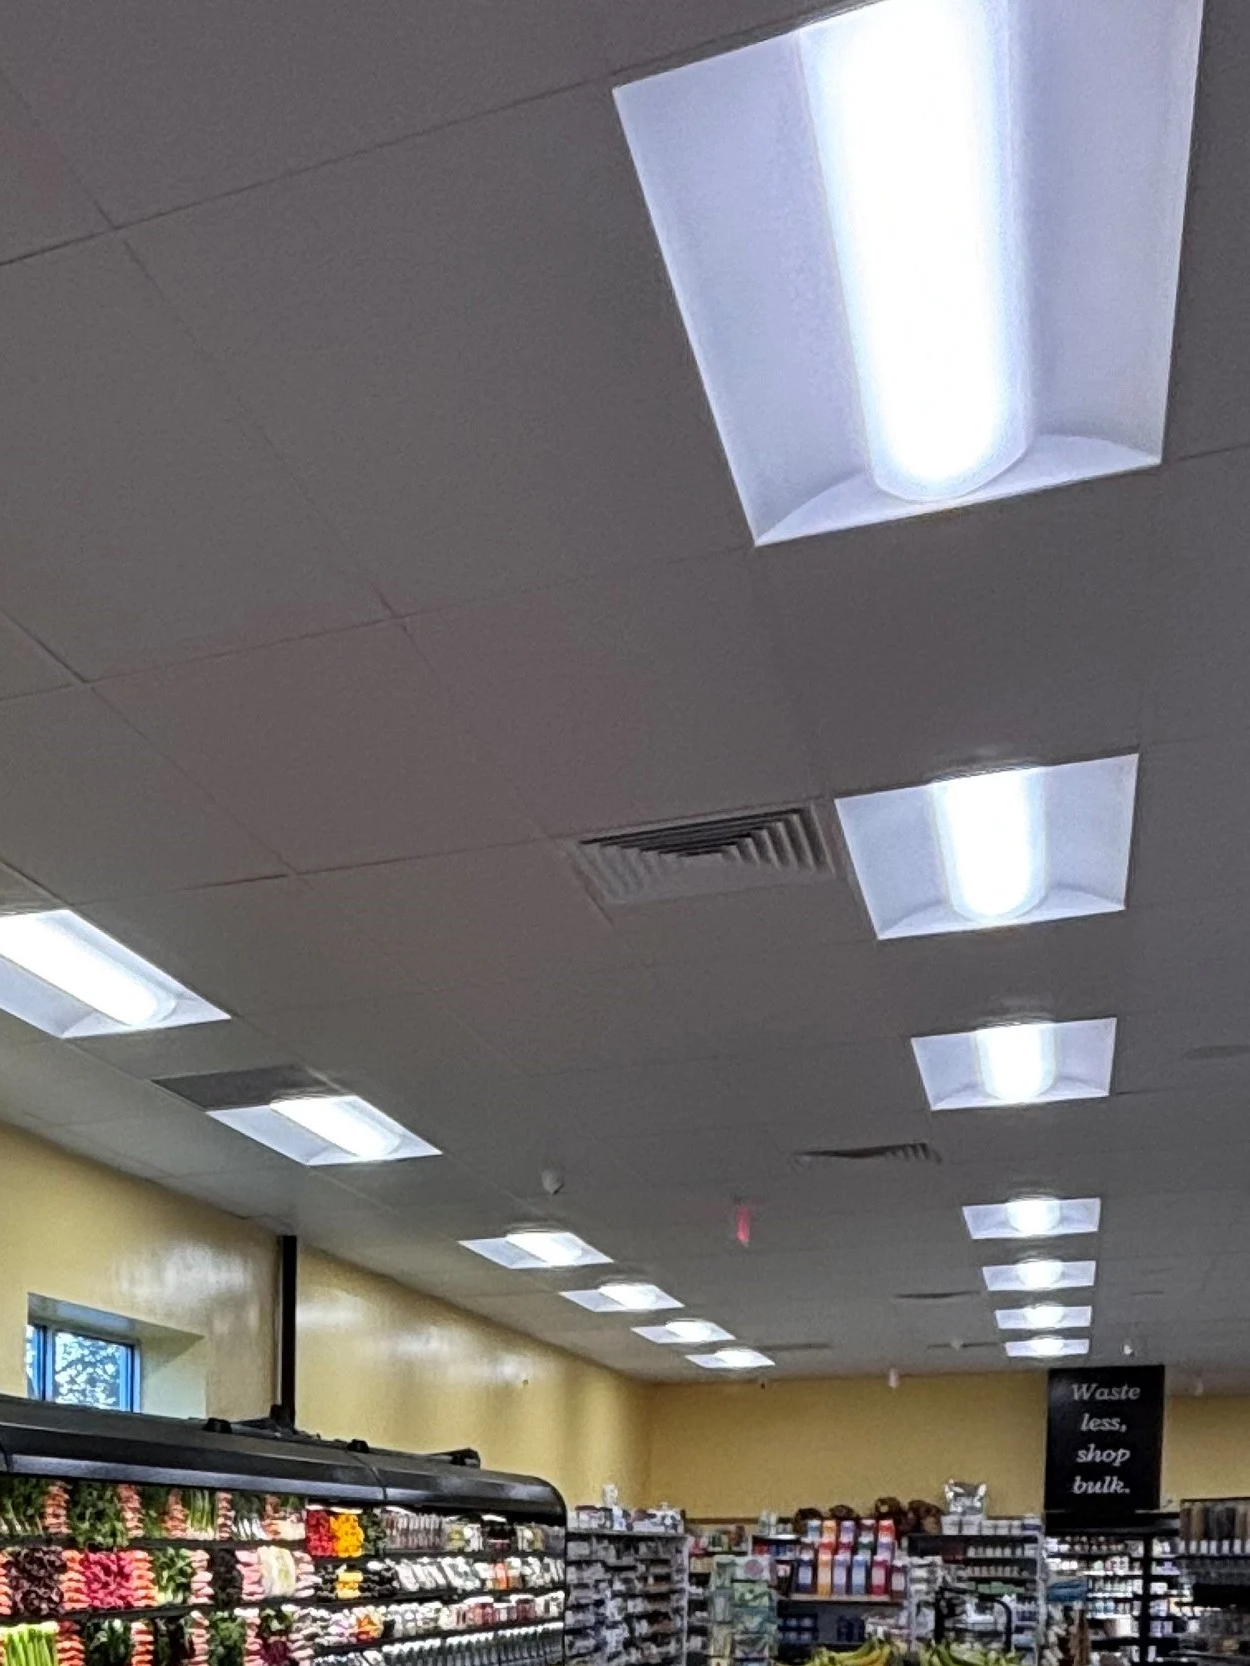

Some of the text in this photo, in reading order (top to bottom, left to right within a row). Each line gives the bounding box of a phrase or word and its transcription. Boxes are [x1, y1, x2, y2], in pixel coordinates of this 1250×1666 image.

[1072, 1383, 1140, 1400] Waste
[1080, 1412, 1127, 1432] less,
[1076, 1443, 1131, 1467] shop
[1072, 1475, 1131, 1494] bulk.
